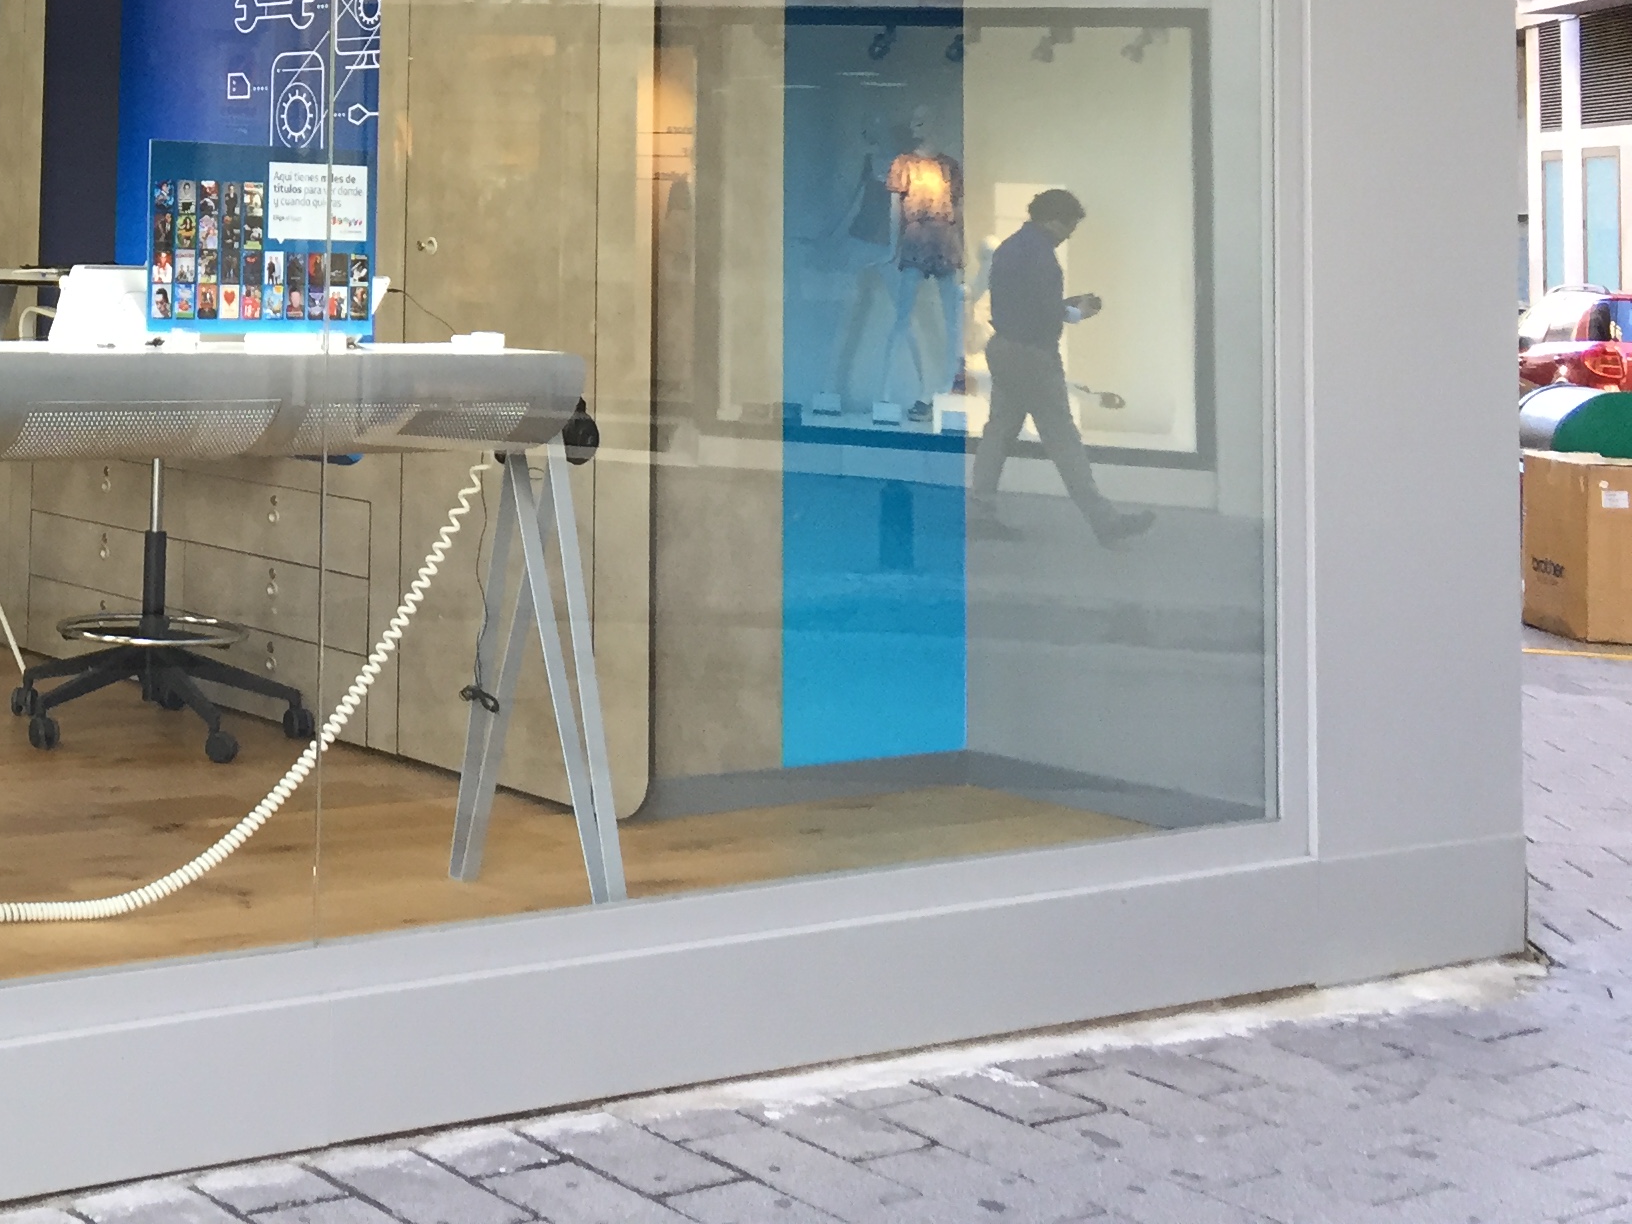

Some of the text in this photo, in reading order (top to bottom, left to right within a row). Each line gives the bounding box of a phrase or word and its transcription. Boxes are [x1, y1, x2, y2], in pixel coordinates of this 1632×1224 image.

[345, 174, 356, 184] de
[273, 183, 302, 194] títulos
[304, 186, 322, 198] para
[280, 196, 311, 207] cuando
